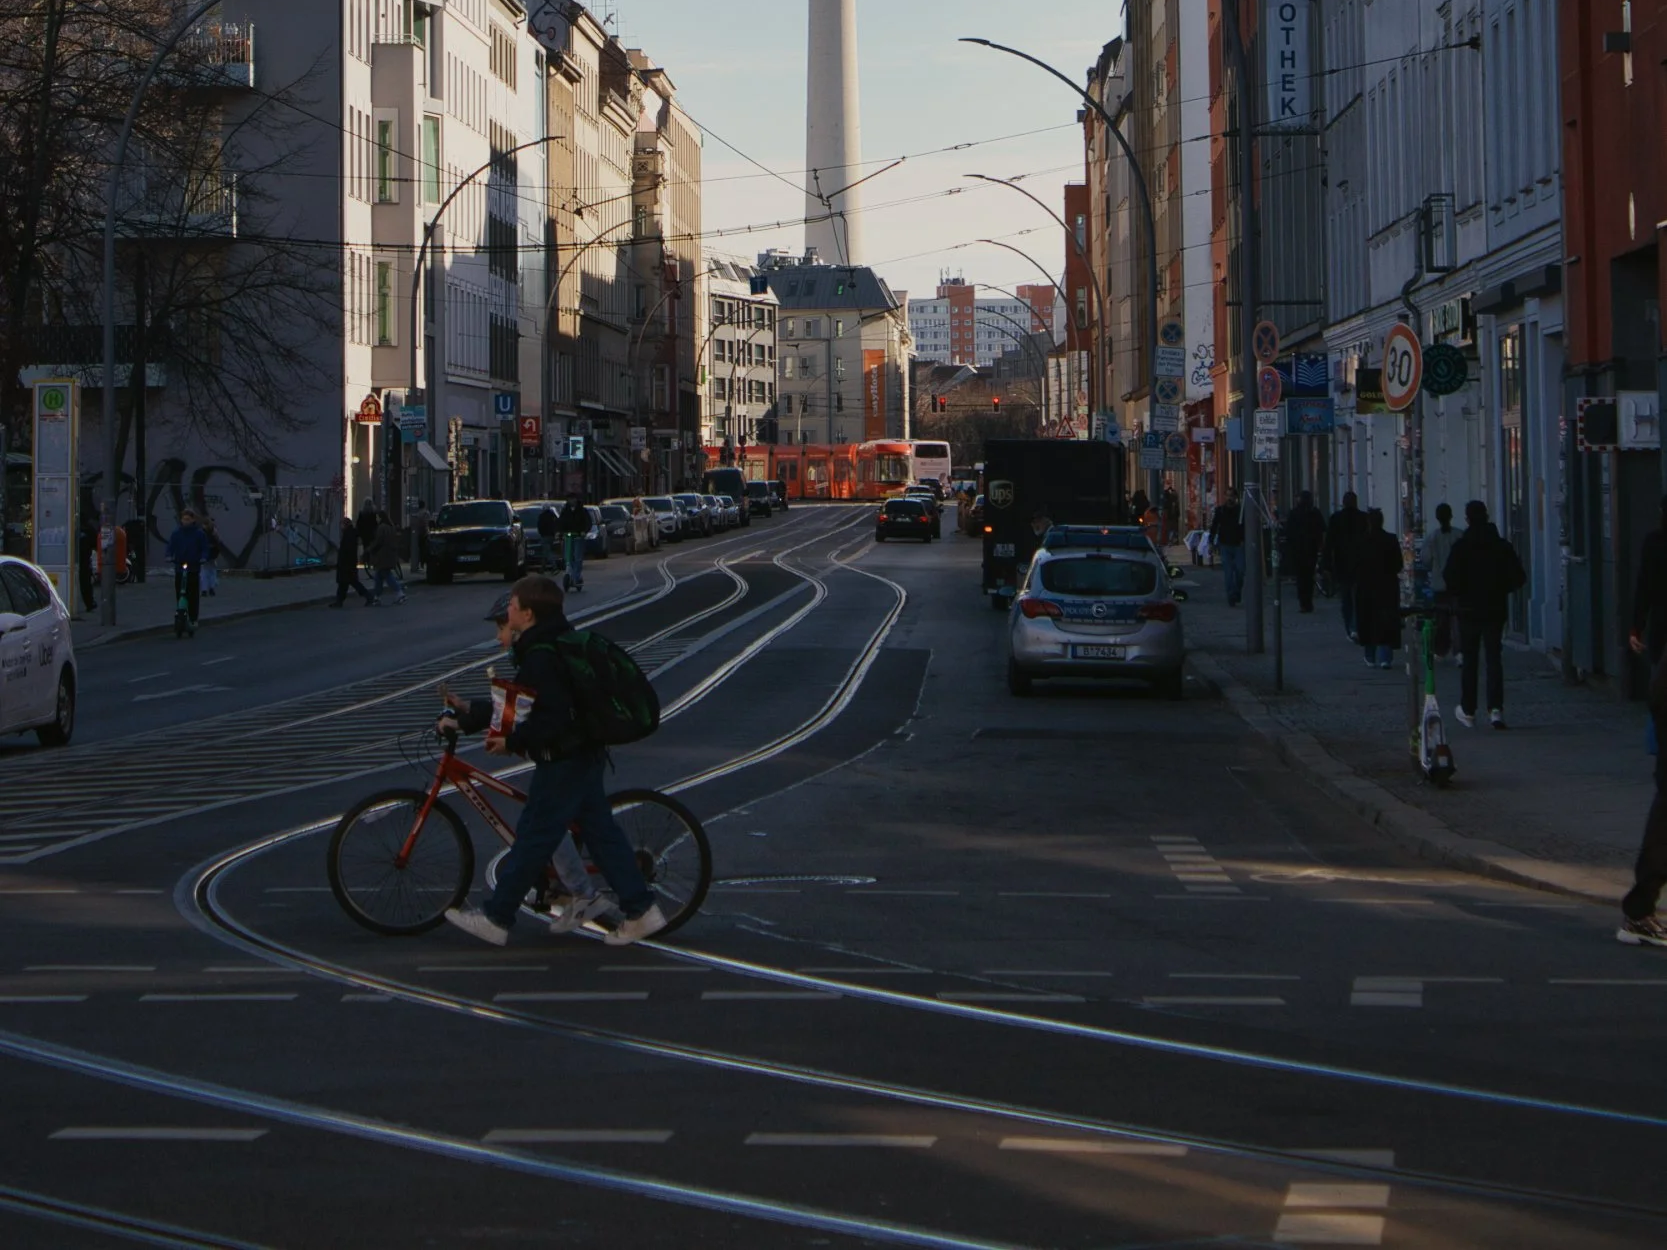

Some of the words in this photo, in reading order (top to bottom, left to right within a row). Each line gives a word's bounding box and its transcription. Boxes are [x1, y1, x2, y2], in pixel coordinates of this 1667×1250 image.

[1387, 347, 1412, 387] 30
[499, 396, 511, 412] U
[870, 364, 879, 418] easyHotel
[992, 489, 1012, 504] ups
